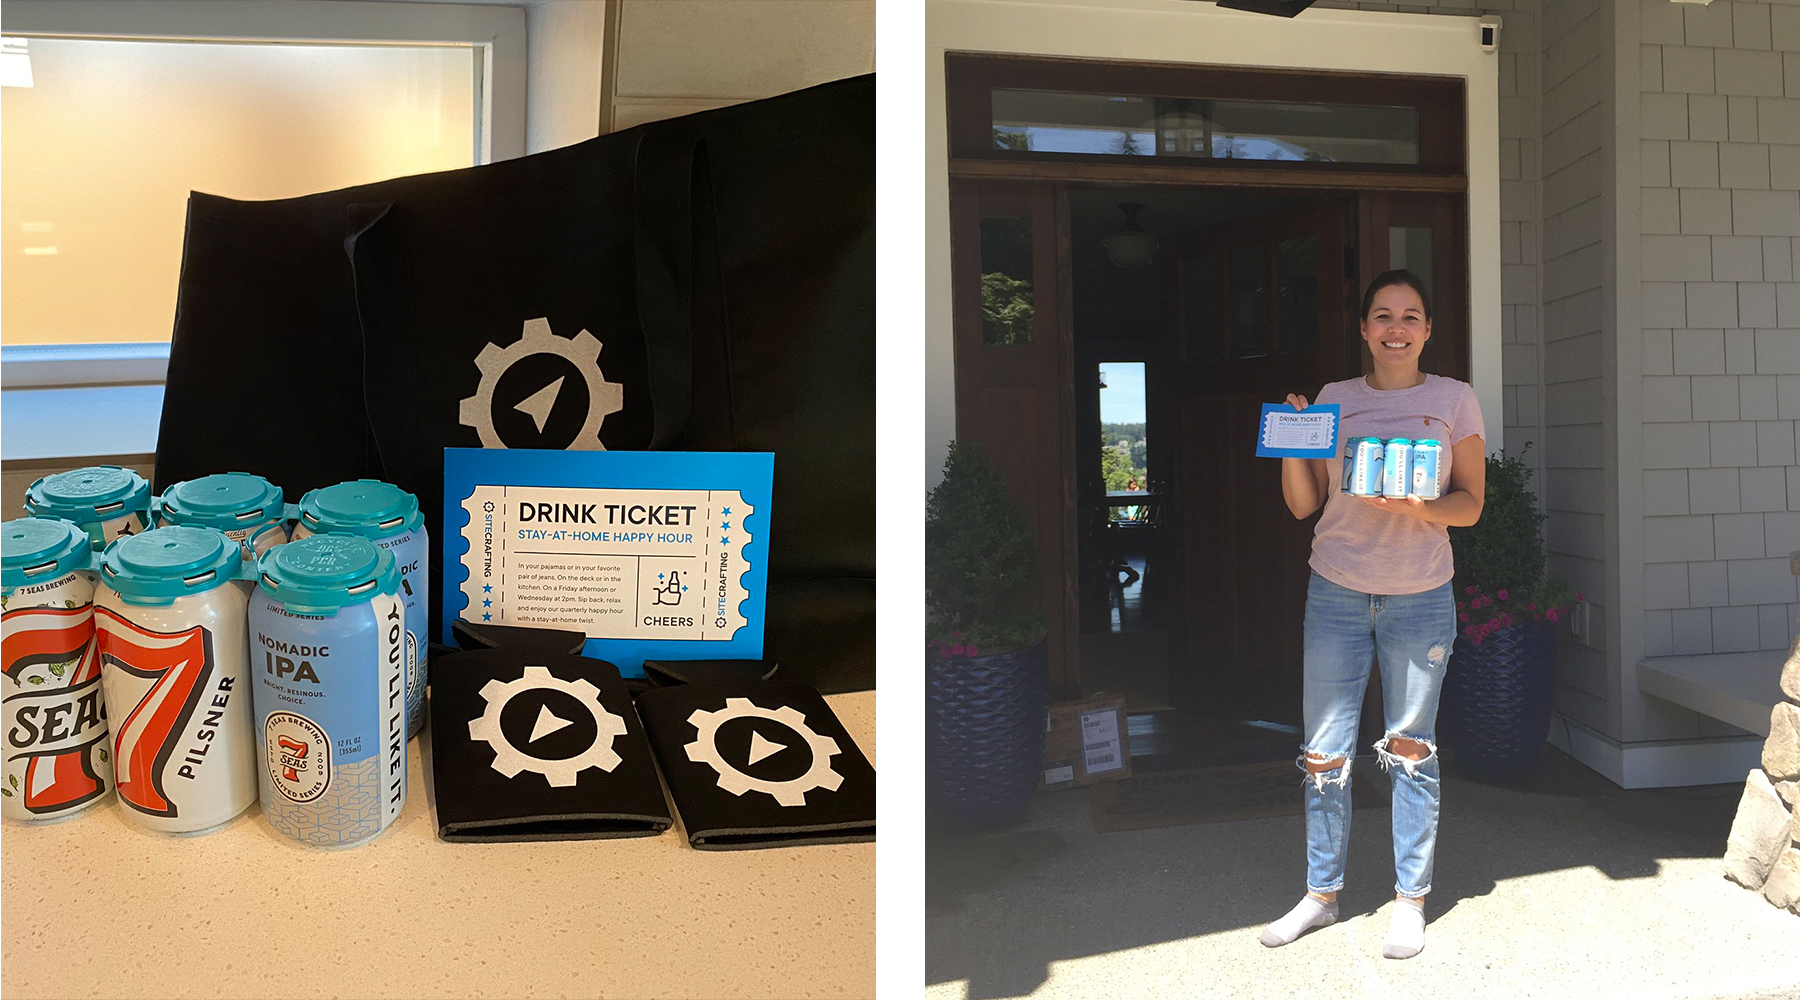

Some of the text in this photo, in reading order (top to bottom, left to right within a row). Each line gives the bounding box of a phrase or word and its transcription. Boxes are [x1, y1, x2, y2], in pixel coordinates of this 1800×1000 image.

[519, 502, 697, 526] DRINK TICKET
[484, 514, 493, 578] SITECRAFTING
[518, 529, 693, 543] STAY-AT-HOME HAPPY HOUR
[310, 557, 337, 565] PCR
[27, 585, 44, 594] SEAS
[46, 575, 76, 591] BREWING
[717, 552, 728, 616] SITECRAFTING
[560, 606, 587, 614] quarterly
[643, 616, 694, 627] CHEERS
[258, 631, 330, 657] NOMADIC
[266, 651, 321, 684] IPA
[263, 678, 326, 698] BRIGHT. RESINOUS.
[277, 694, 306, 705] CHOICE.
[95, 605, 214, 818] 7
[388, 602, 401, 813] YOU'LL LIKE IT.
[177, 676, 236, 780] PILSNER
[272, 716, 287, 728] SEAS
[288, 717, 323, 745] BREWING
[280, 754, 308, 769] SEAS
[339, 745, 361, 756] (355ml)
[272, 769, 323, 799] LIMITED SERIES
